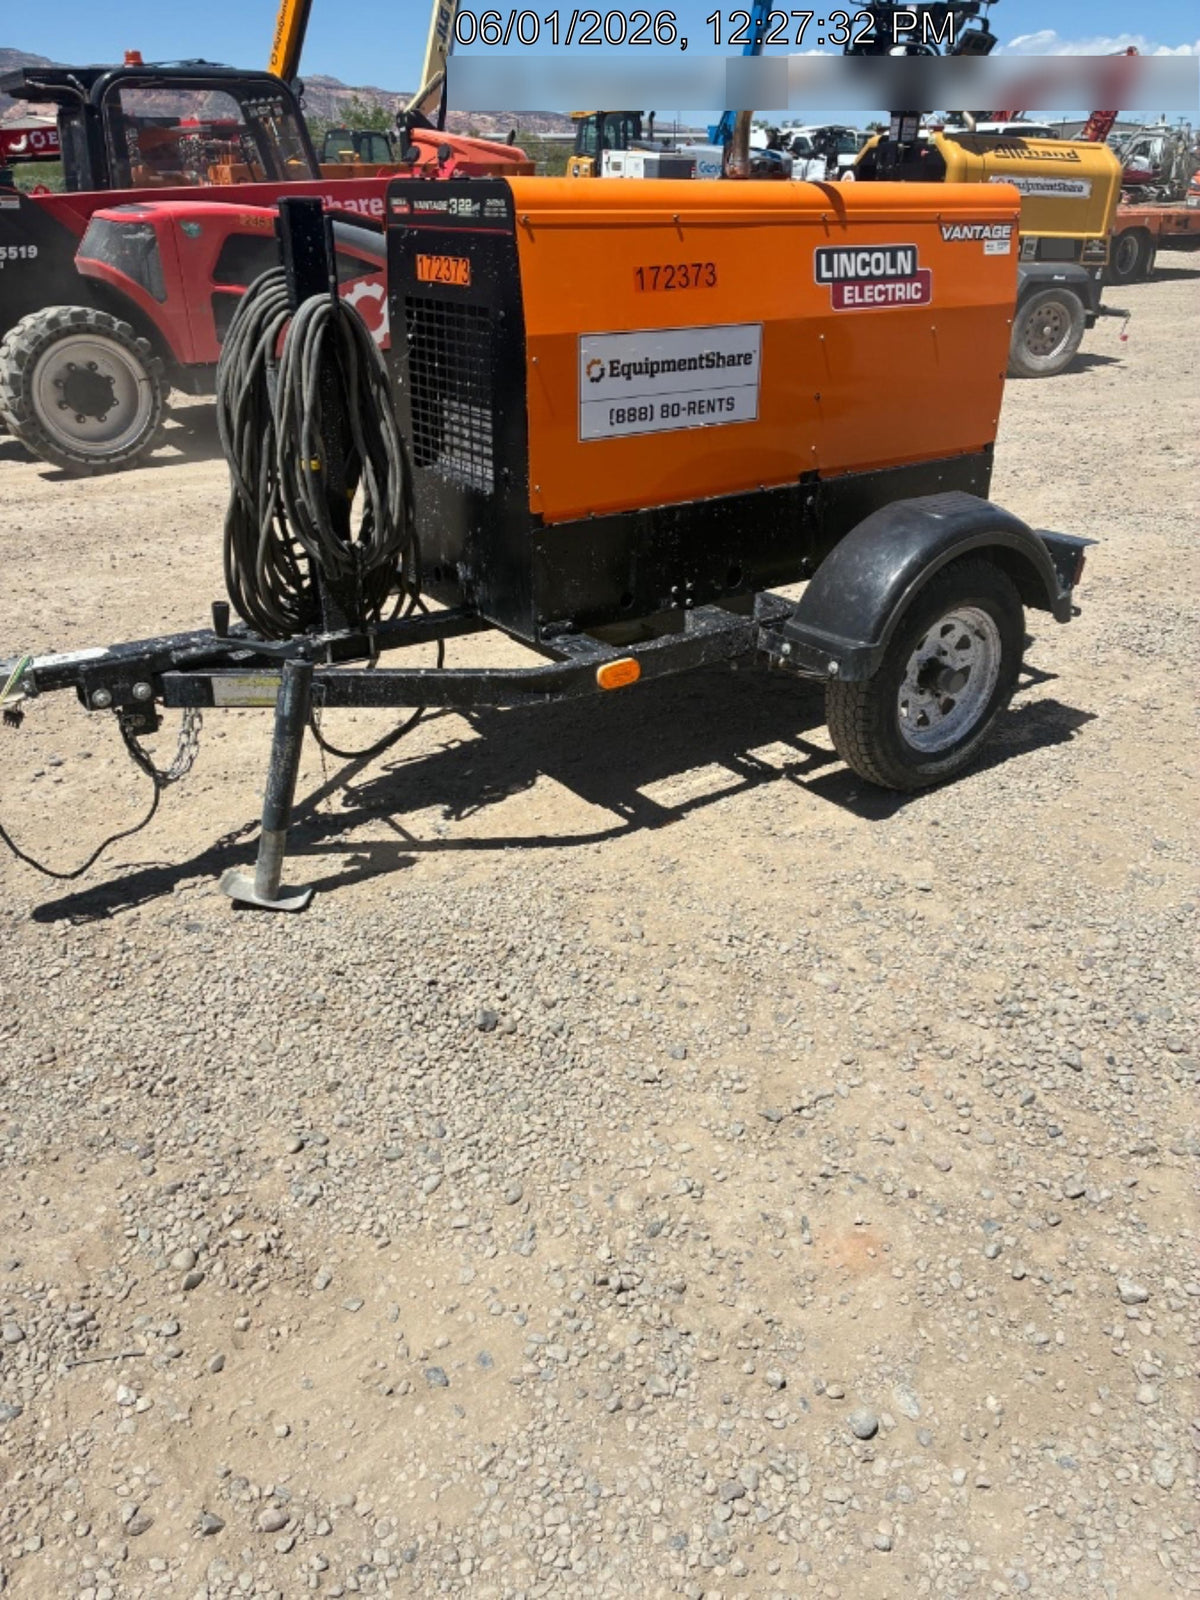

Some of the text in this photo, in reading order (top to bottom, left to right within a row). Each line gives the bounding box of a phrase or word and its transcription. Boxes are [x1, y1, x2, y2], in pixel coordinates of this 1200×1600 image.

[437, 5, 451, 44] JLG
[1007, 179, 1084, 193] uipmentShare
[941, 224, 1012, 241] VANTAGE
[418, 257, 469, 284] 172373
[635, 262, 718, 291] 172373
[820, 250, 913, 279] LINCOLN
[843, 282, 923, 305] ELECTRIC
[608, 351, 753, 380] EquipmentShare
[609, 396, 736, 426] (888) 80-RENTS
